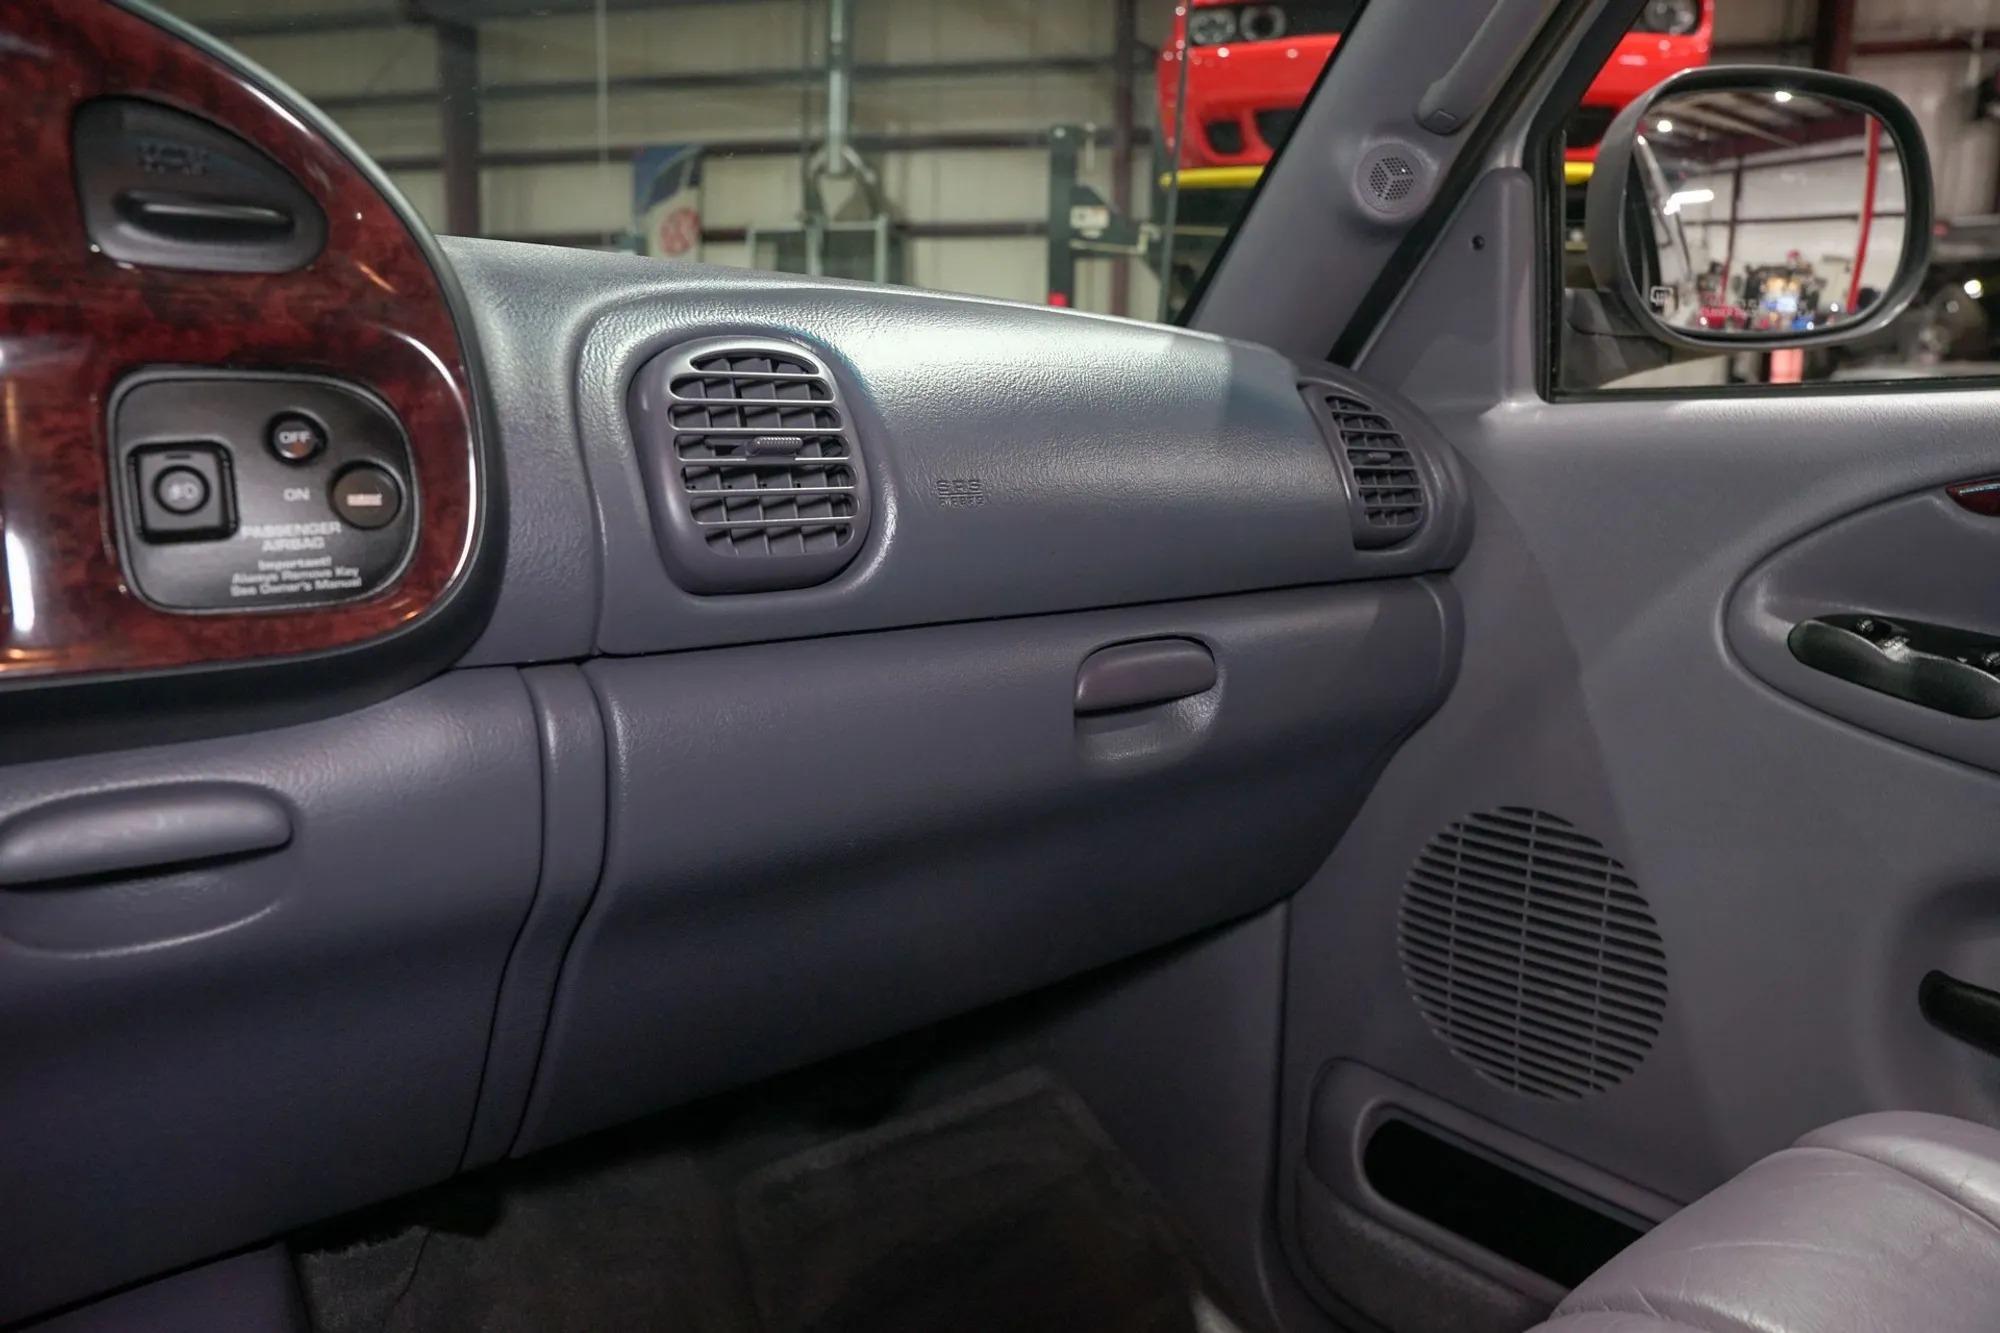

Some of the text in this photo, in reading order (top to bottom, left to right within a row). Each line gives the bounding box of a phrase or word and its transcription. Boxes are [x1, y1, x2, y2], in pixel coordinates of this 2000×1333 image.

[279, 431, 310, 443] OFF
[283, 487, 311, 502] ON
[241, 522, 341, 539] PASSENGER
[262, 537, 325, 551] AIRBAG
[335, 566, 359, 579] Key
[231, 586, 257, 597] See
[314, 577, 362, 590] Manual
